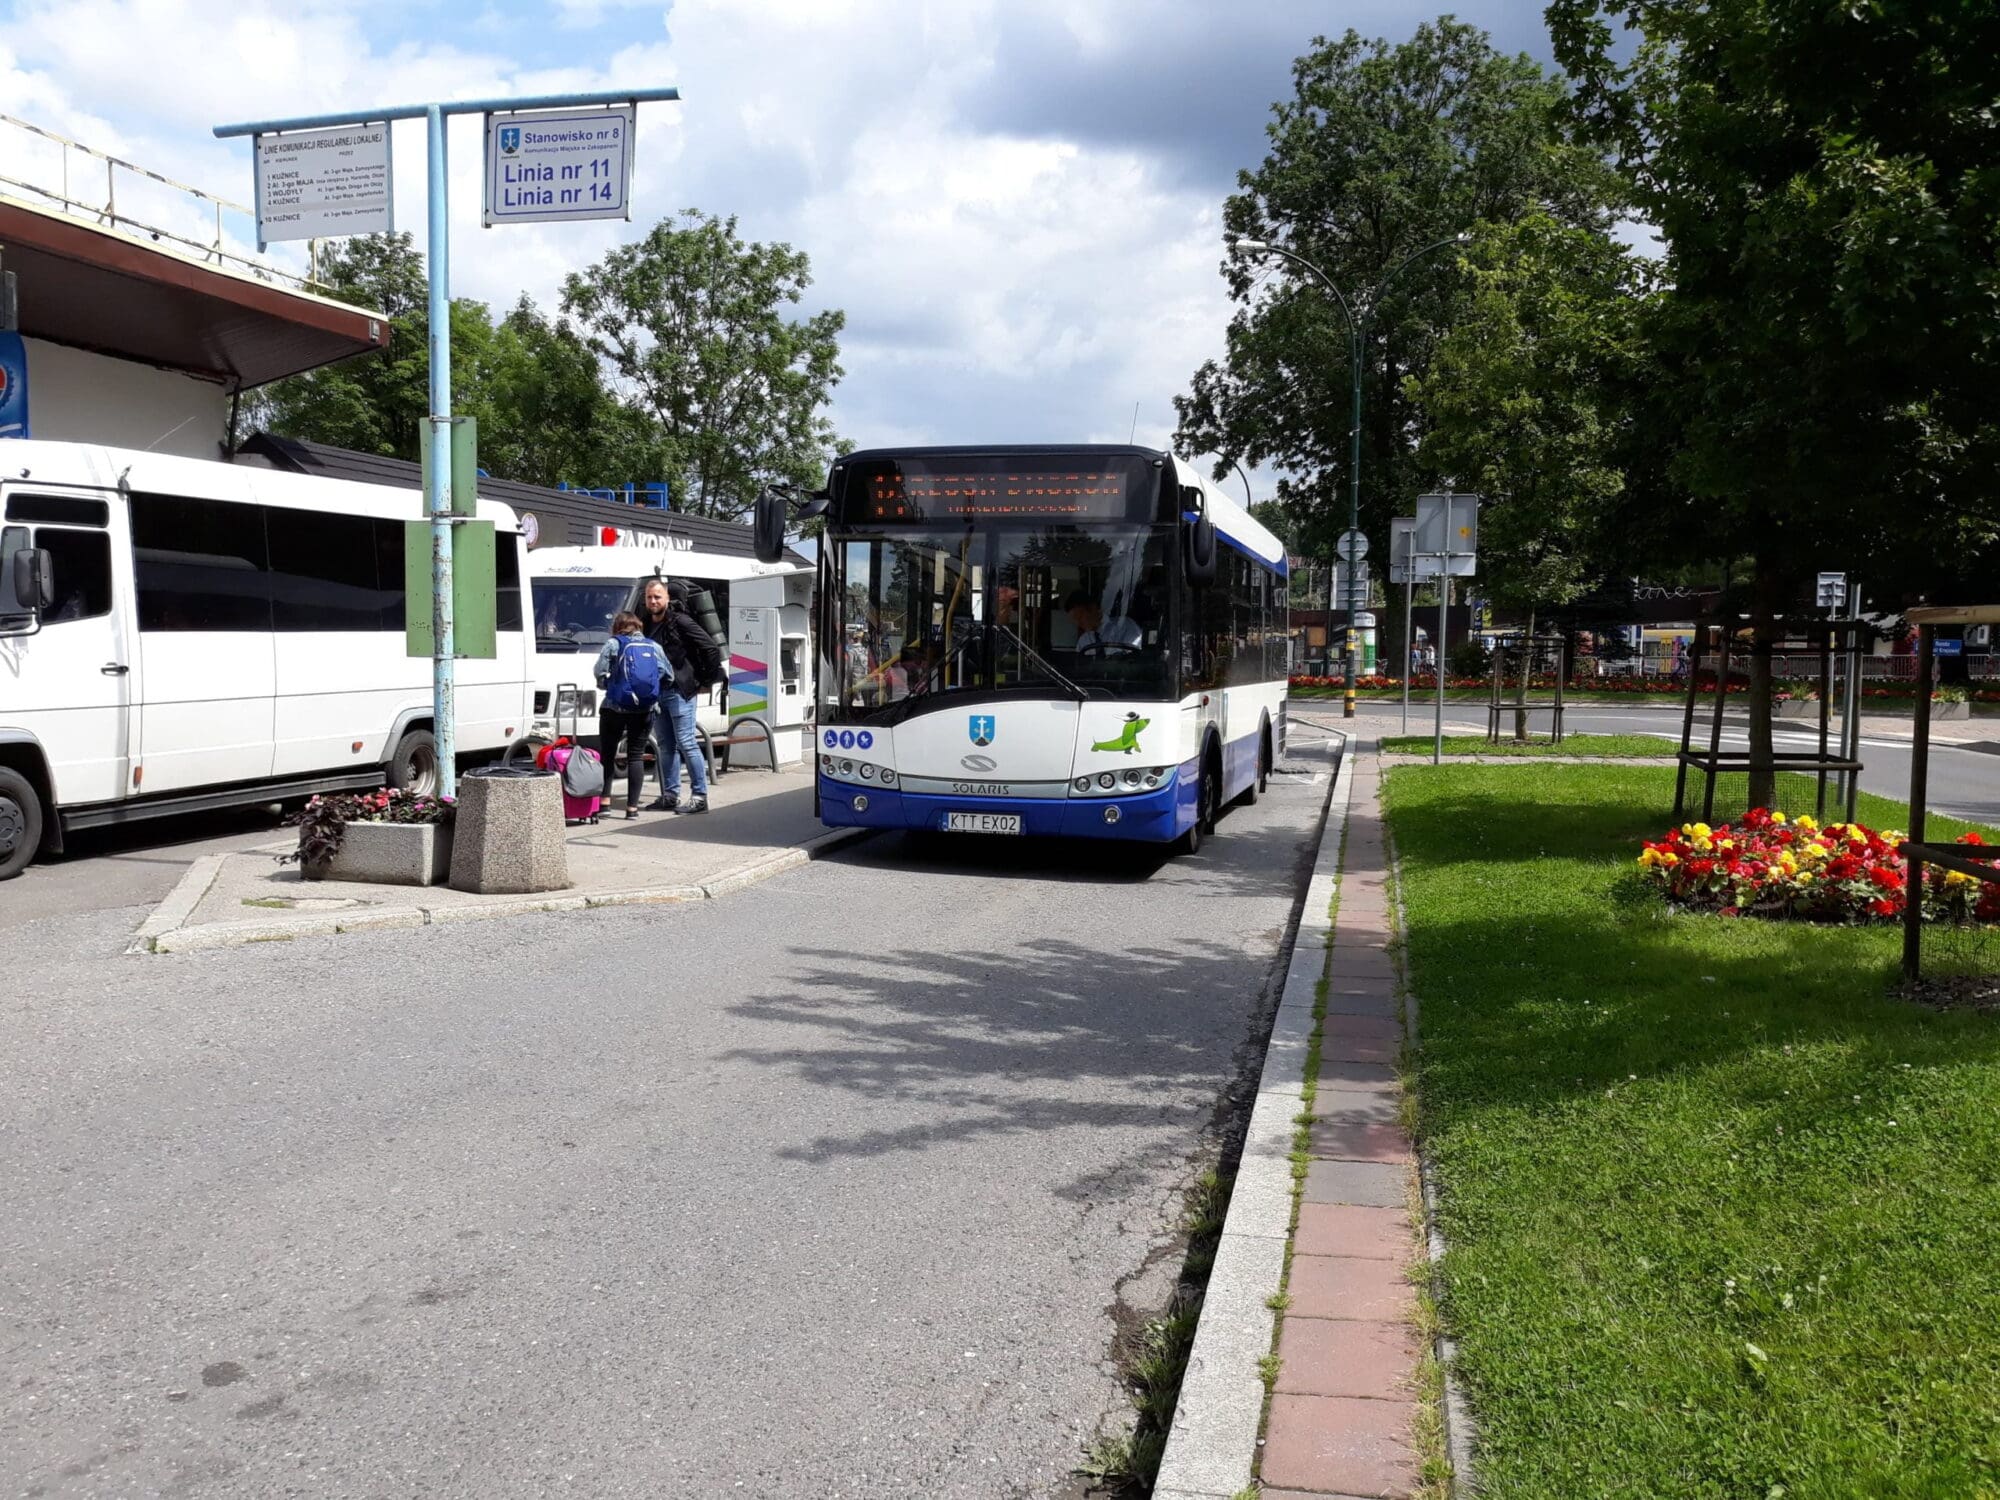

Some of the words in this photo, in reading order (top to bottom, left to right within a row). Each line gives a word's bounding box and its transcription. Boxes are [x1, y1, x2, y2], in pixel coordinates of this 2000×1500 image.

[264, 144, 279, 154] LINIE
[279, 141, 316, 152] KOMUNIKACJI
[316, 137, 353, 149] REGULARNEJ
[353, 134, 383, 145] LOKALNEJ
[524, 130, 593, 144] Stanowisko
[596, 130, 609, 140] nr
[612, 128, 619, 138] 8
[587, 143, 618, 151] Zakopanem
[505, 162, 554, 183] Linia
[561, 164, 583, 180] nr
[590, 159, 609, 178] 11
[504, 186, 553, 206] Linia
[561, 188, 582, 203] nr
[589, 182, 612, 201] 14
[952, 783, 1010, 795] SOLARIS
[951, 814, 978, 828] KTT
[982, 816, 1017, 831] EX02
